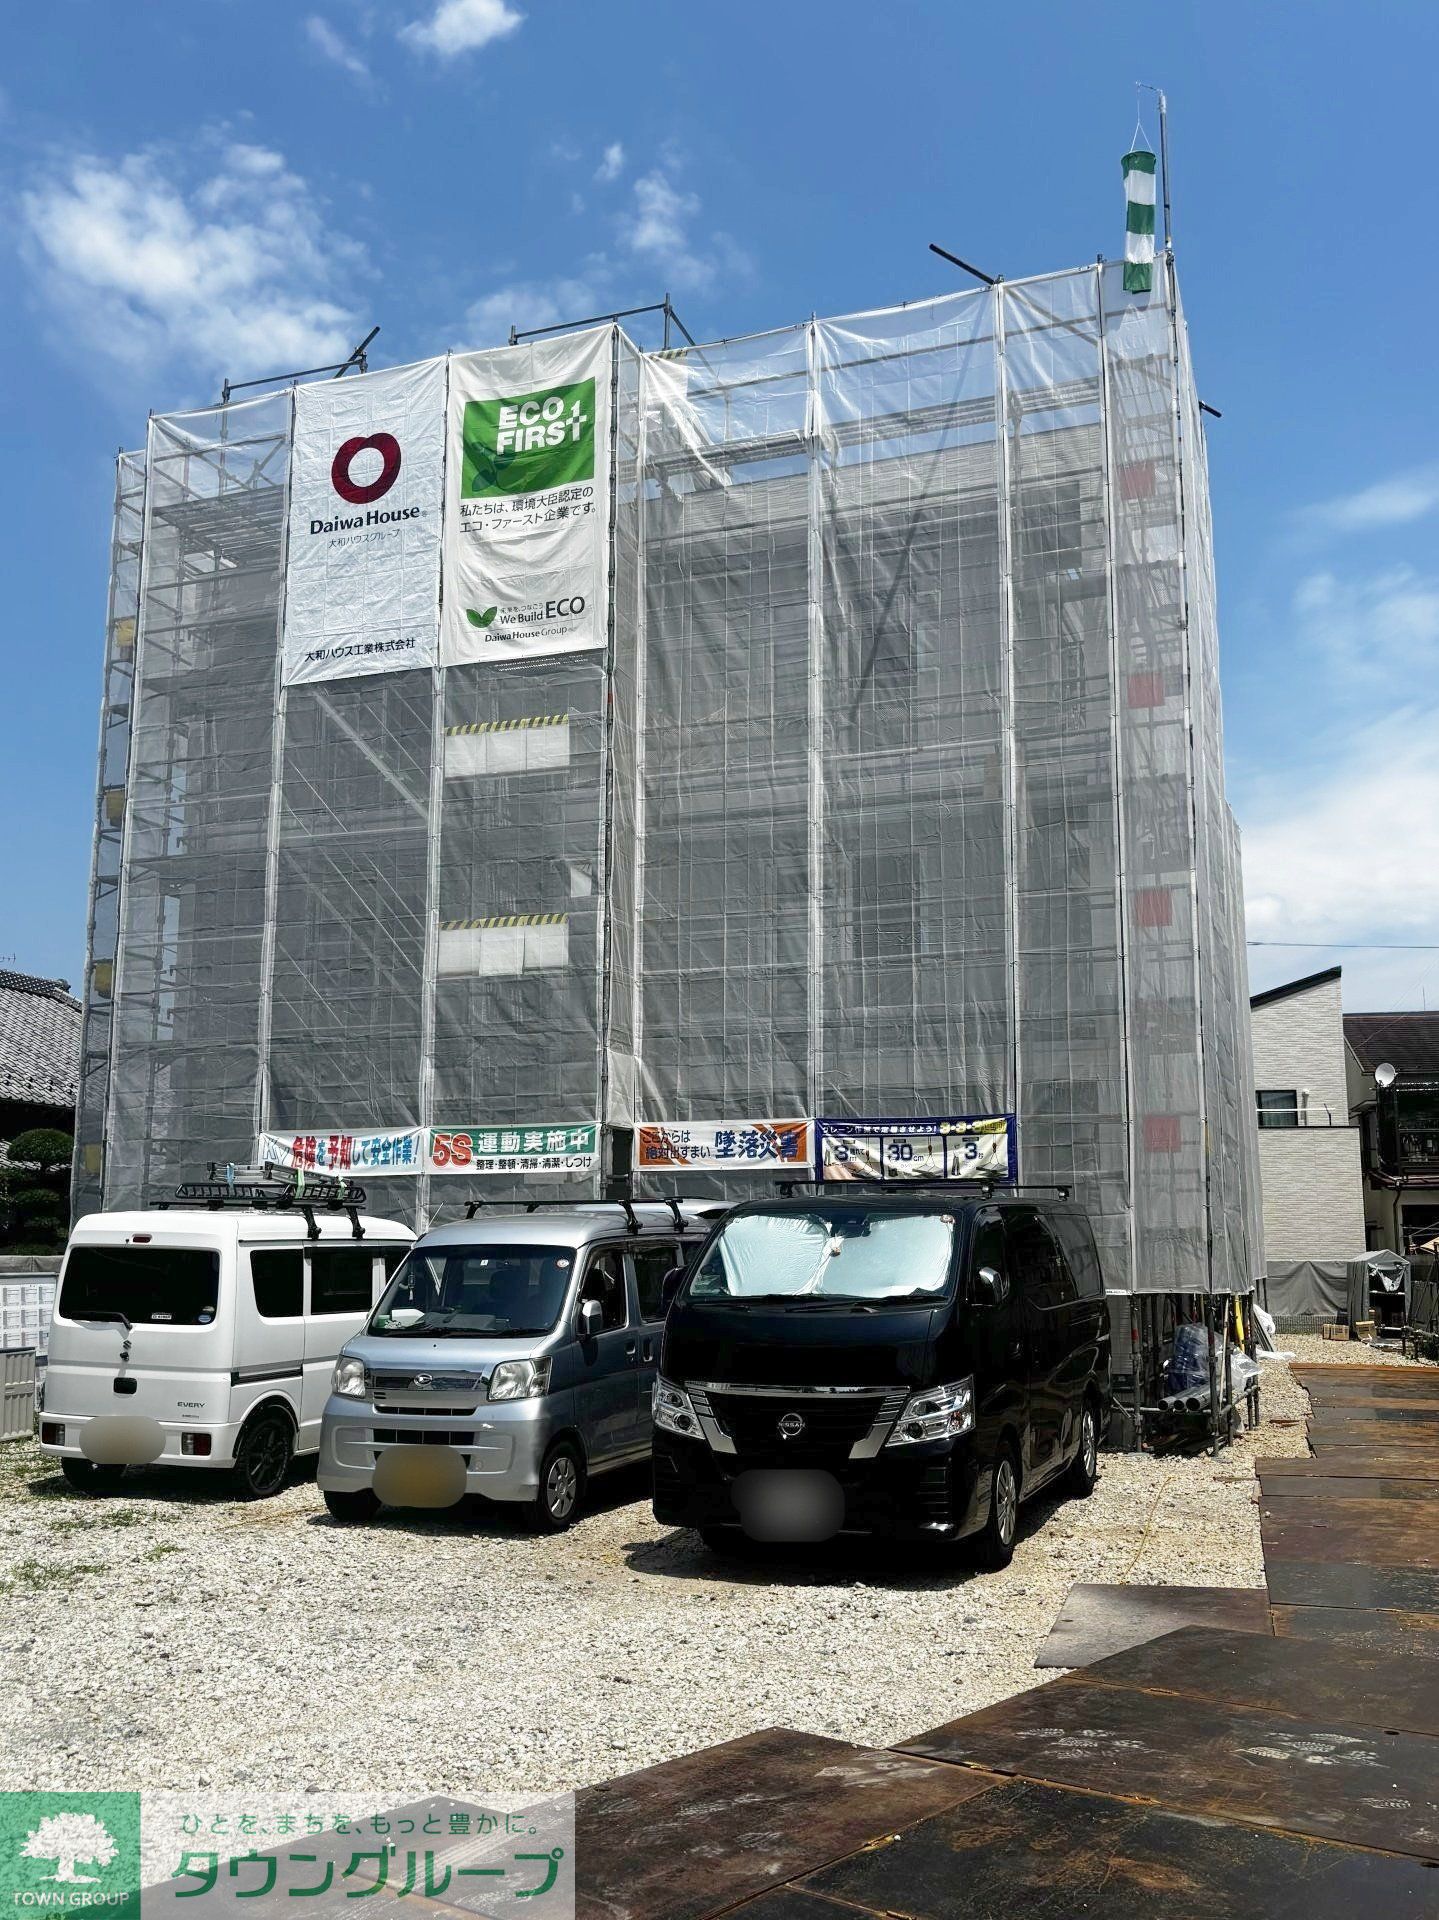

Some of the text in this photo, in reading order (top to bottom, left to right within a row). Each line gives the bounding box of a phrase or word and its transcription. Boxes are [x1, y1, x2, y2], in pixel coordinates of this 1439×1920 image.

[498, 396, 565, 430] ECO
[459, 486, 594, 518] 私たちは、環境大臣認定の
[310, 506, 420, 535] Daiwa House
[459, 501, 596, 533] エコ・ファースト企業です。
[328, 528, 401, 549] 大和ハウスグループ
[500, 596, 586, 625] We Build ECO
[484, 626, 568, 642] Daiwa House Group
[304, 637, 416, 662] 大和ハウス工業株式会社
[431, 1129, 590, 1168] 5S 運動実施中
[641, 1129, 691, 1144] ここからは
[715, 1130, 799, 1160] 墜落災害
